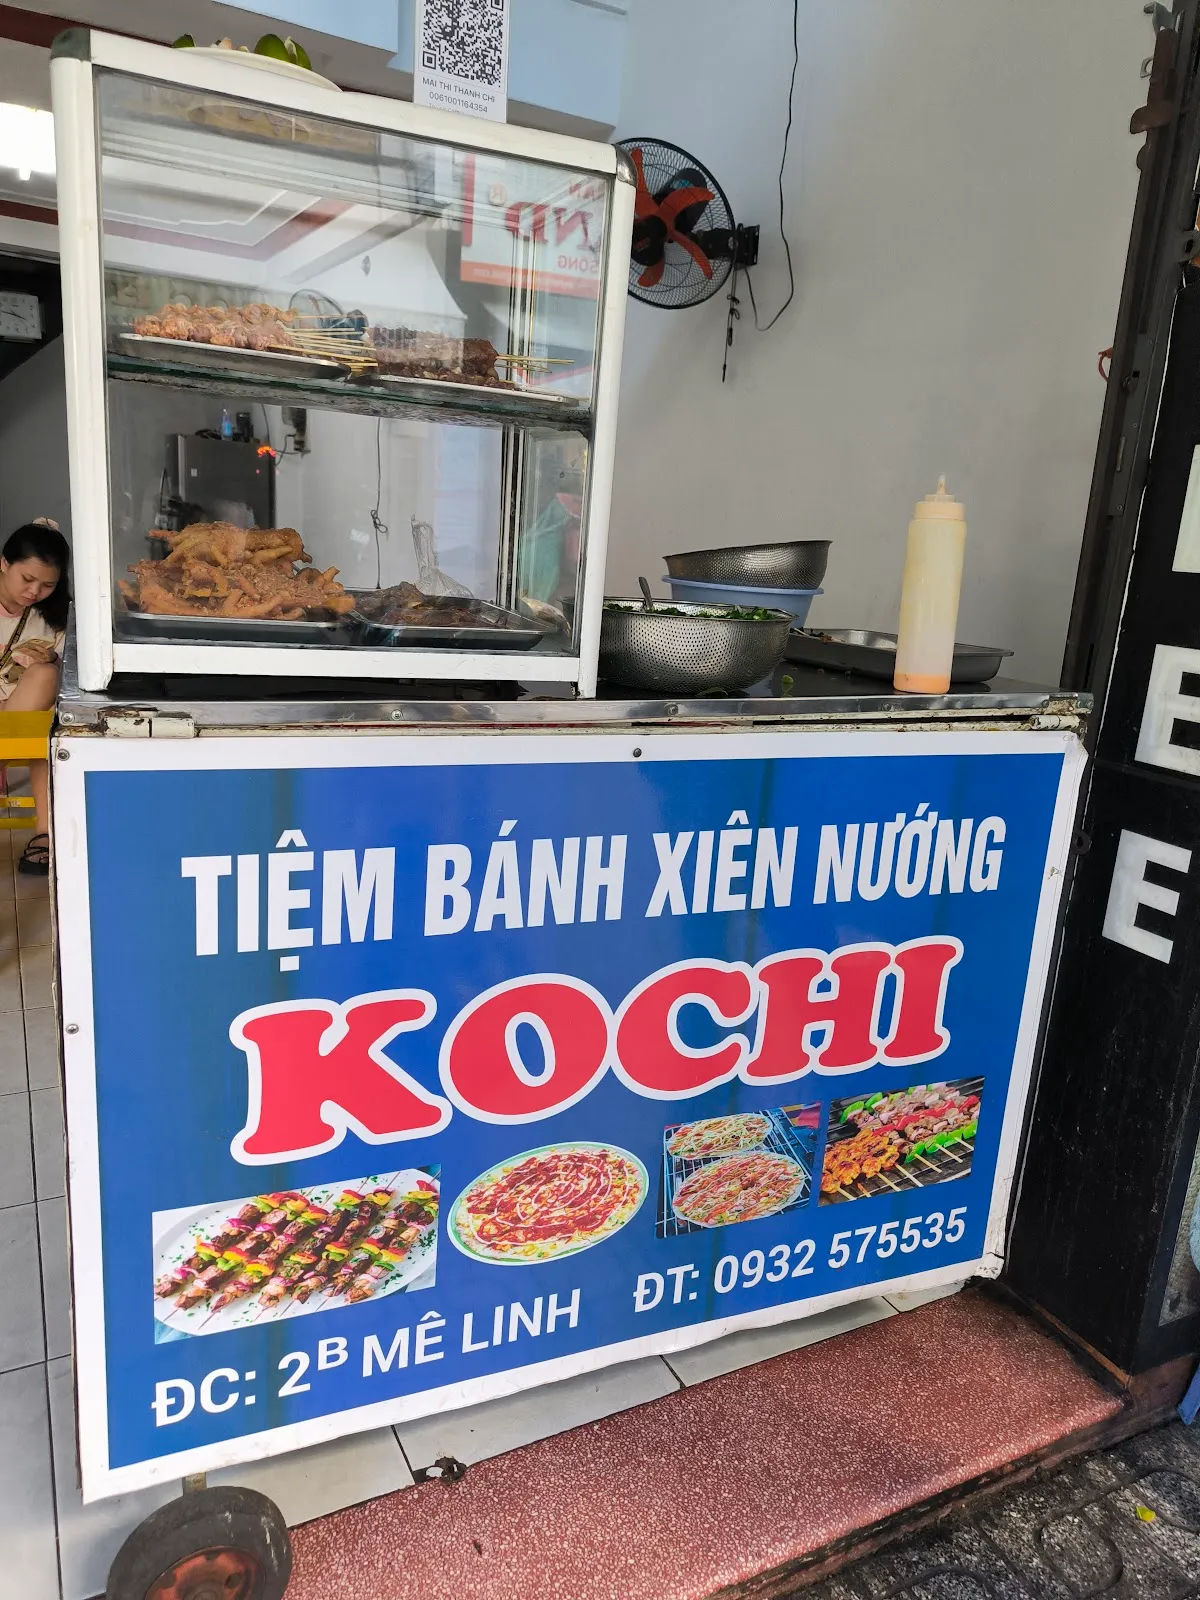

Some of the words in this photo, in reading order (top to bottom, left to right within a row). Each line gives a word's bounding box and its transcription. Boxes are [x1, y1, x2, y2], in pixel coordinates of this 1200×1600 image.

[422, 77, 437, 87] MAI
[440, 81, 451, 92] THI
[454, 85, 481, 98] THANH
[429, 91, 488, 113] 0061001164354
[181, 830, 395, 971] TIỆM
[424, 820, 627, 936] BÁNH
[645, 810, 798, 917] XIÊN
[814, 803, 1005, 904] NƯỚNG
[229, 936, 963, 1165] KOCHI
[634, 1265, 698, 1313] ĐT:
[713, 1240, 815, 1296] 0932
[829, 1207, 966, 1268] 575535
[151, 1368, 255, 1427] ĐC:
[363, 1311, 445, 1377] MÊ
[462, 1289, 580, 1353] LINH
